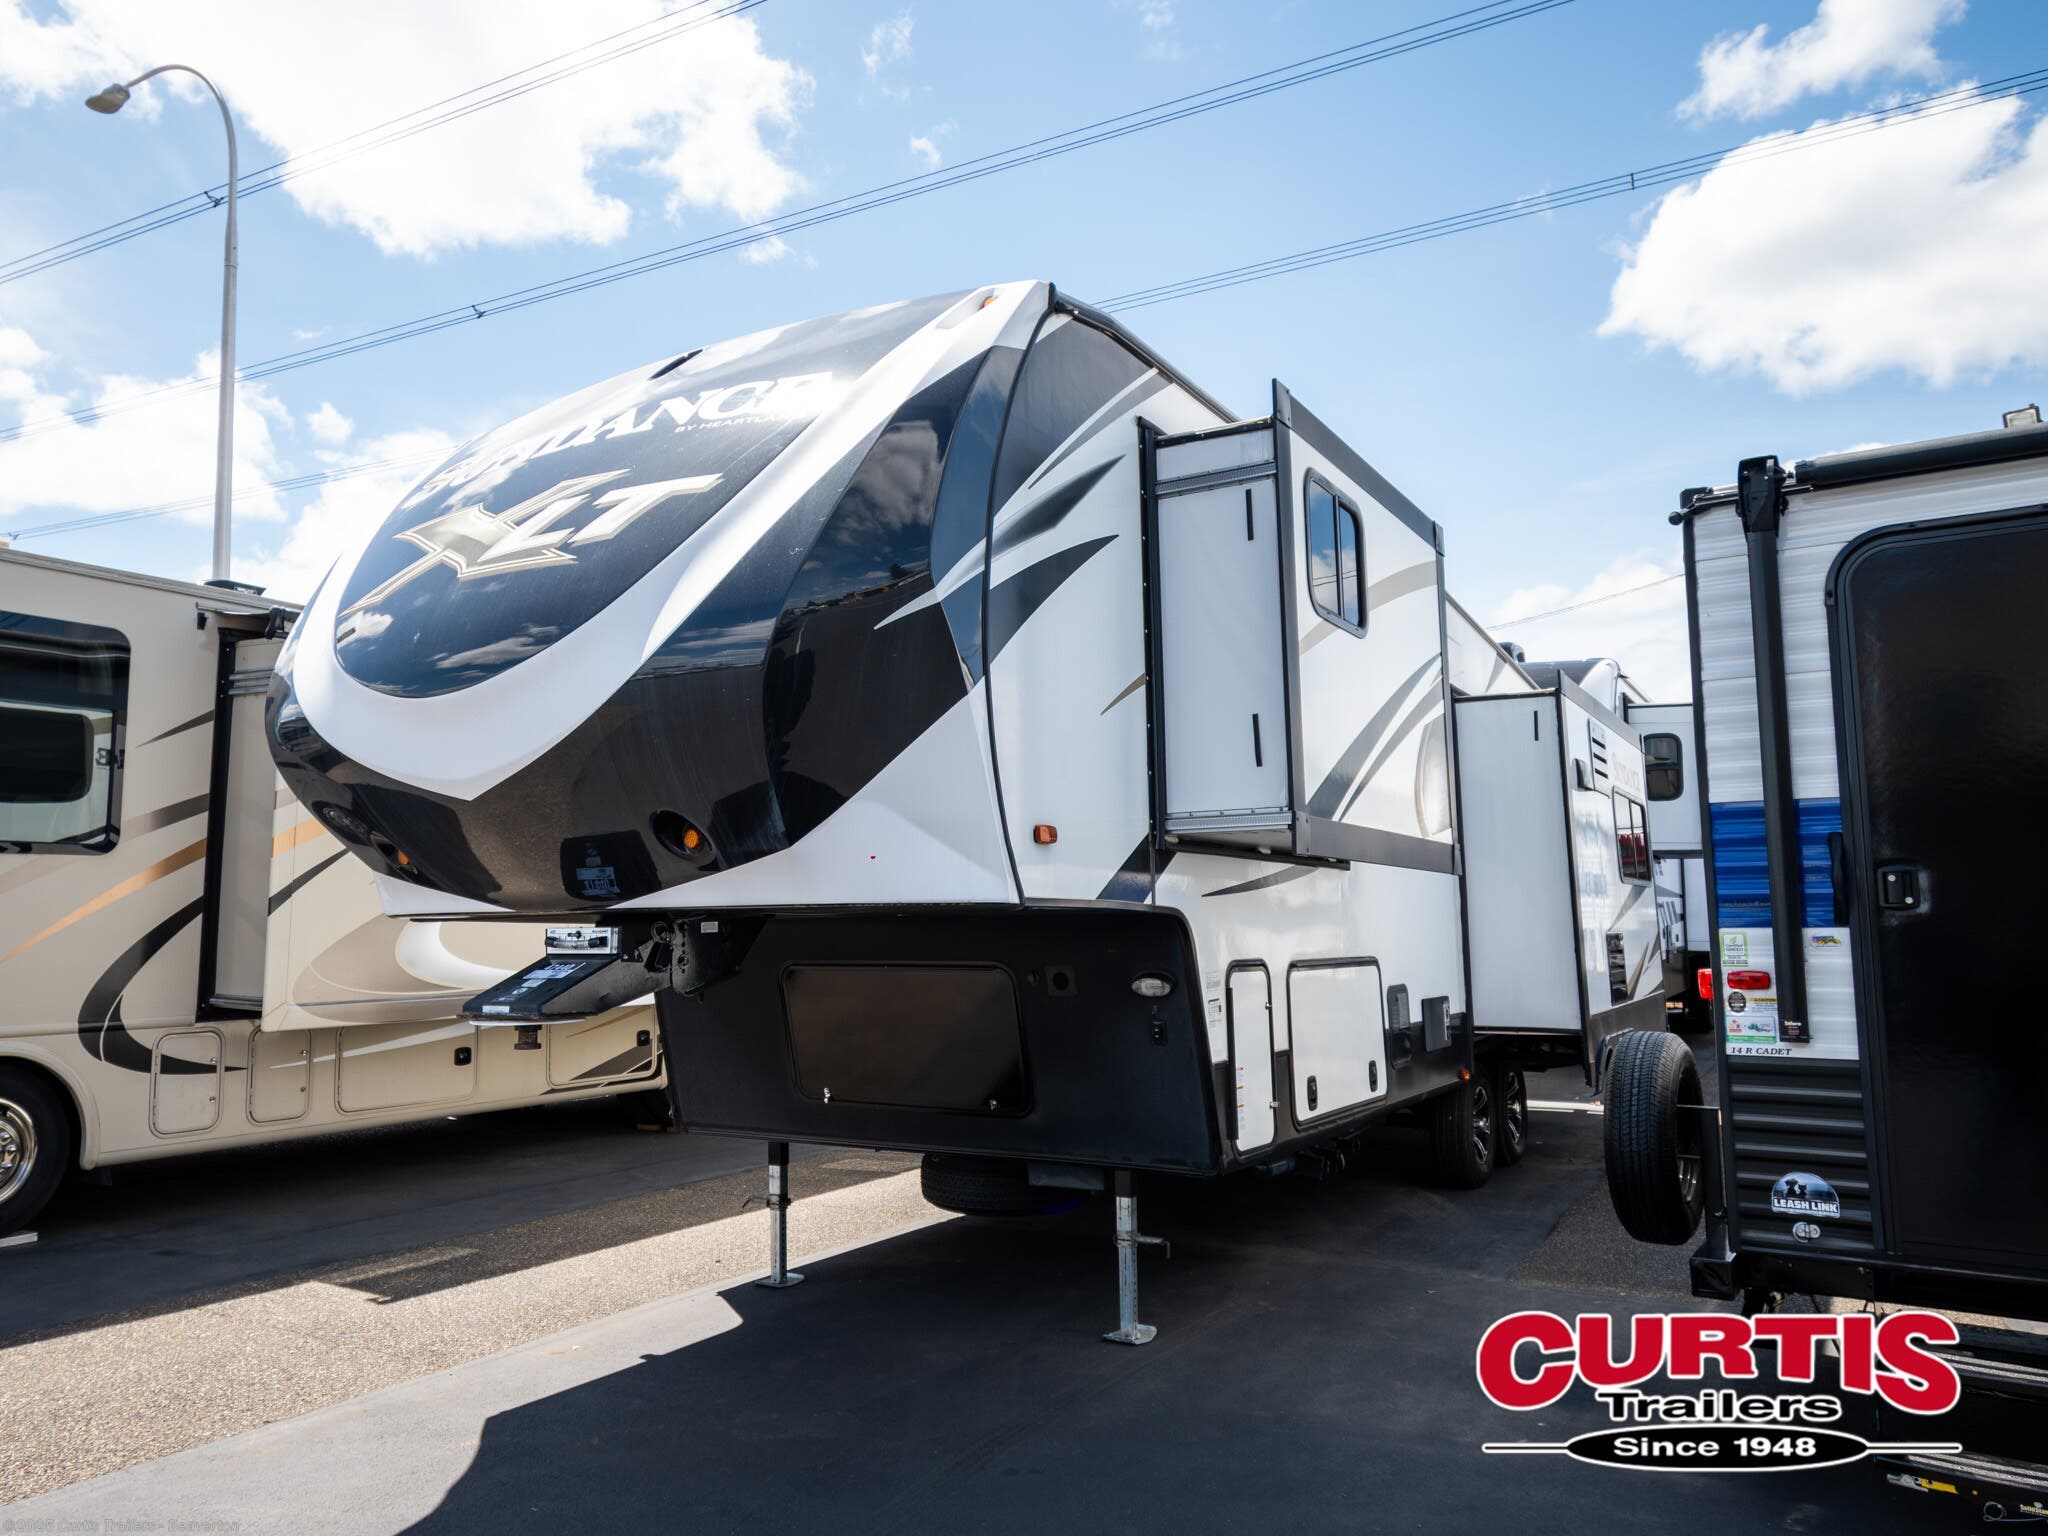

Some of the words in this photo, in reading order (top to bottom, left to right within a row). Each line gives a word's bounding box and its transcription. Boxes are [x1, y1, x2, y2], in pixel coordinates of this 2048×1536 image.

[674, 423, 697, 433] BY
[699, 412, 796, 431] HEARTLA
[1755, 1047, 1793, 1056] CADET
[1773, 1198, 1809, 1210] LEASH
[1811, 1201, 1838, 1213] LINK
